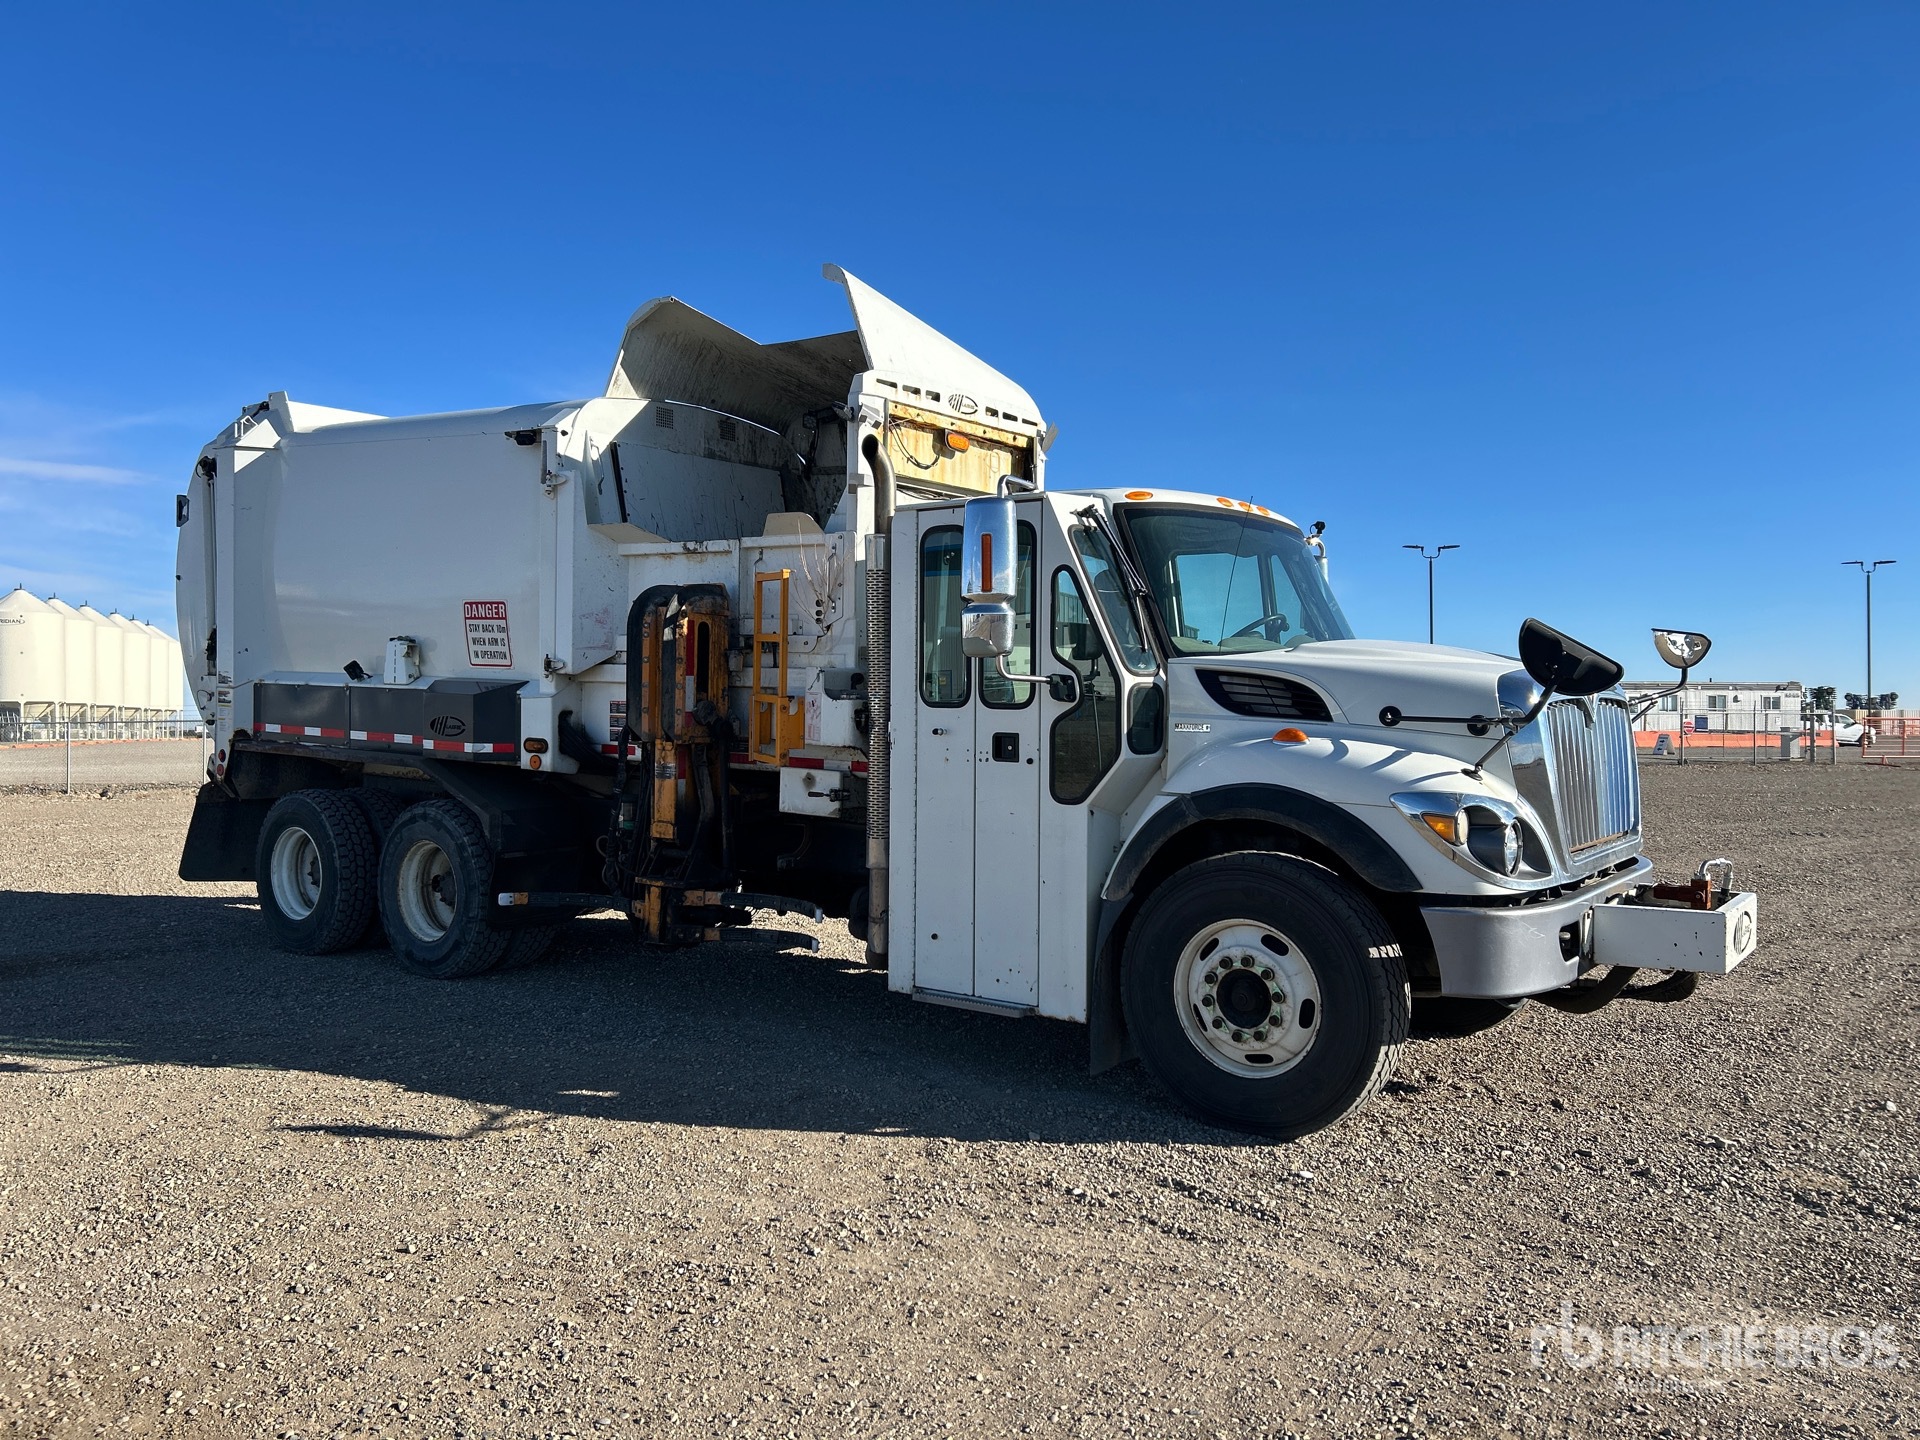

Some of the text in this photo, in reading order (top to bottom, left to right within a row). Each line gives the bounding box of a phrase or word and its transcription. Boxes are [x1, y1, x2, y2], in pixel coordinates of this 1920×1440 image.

[464, 604, 506, 618] DANGER
[468, 623, 480, 633] STAY
[481, 624, 495, 633] BACK
[472, 637, 506, 647] WHEN ARM IS
[474, 650, 507, 660] IN OPERATION
